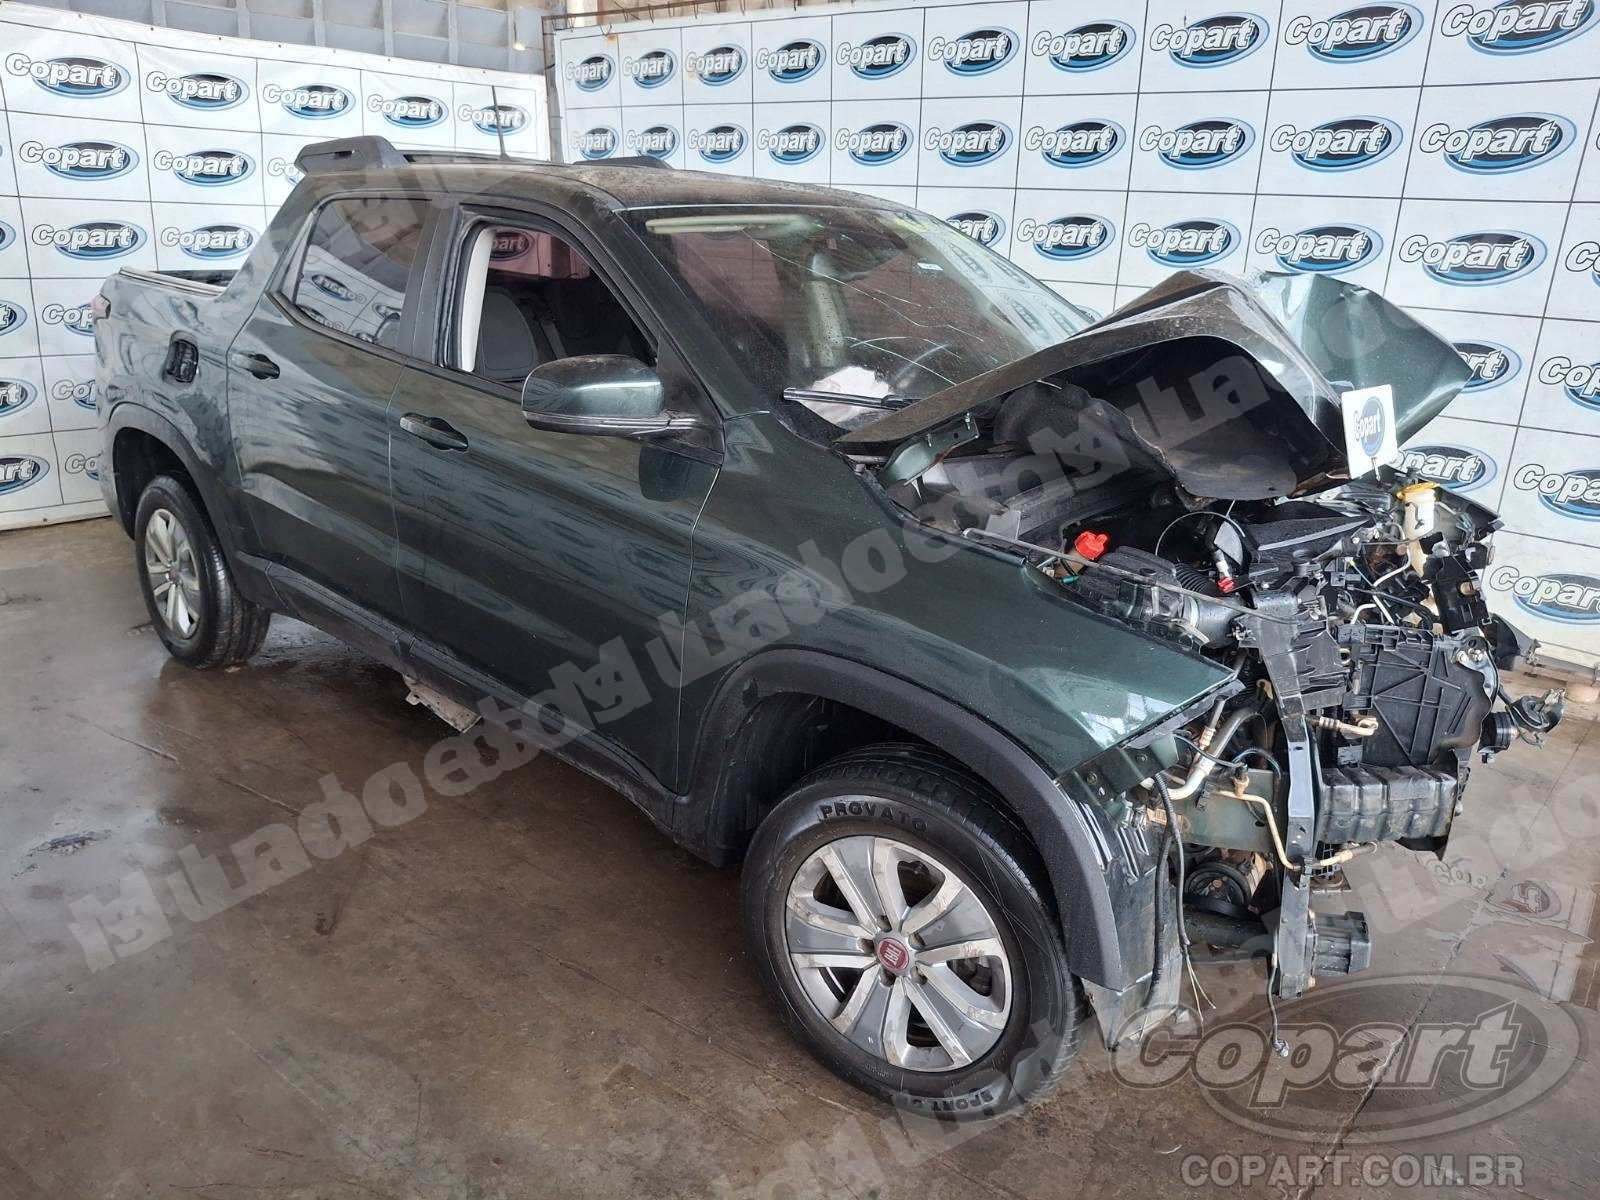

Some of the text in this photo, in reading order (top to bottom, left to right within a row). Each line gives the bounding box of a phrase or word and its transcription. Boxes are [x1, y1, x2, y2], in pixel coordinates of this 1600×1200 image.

[1285, 8, 1409, 52] Copart
[1441, 0, 1588, 43] Copart
[928, 32, 1008, 67] Copart
[1032, 26, 1122, 63] Copart
[1150, 19, 1254, 58] Copart
[5, 53, 117, 87] Copart
[623, 54, 671, 81] Copart
[685, 49, 738, 78] Copart
[756, 44, 817, 74] Copart
[836, 39, 907, 70] Copart
[146, 71, 237, 100] Copart
[565, 60, 609, 85] Copart
[263, 84, 345, 111] Copart
[367, 94, 439, 119] Copart
[458, 104, 522, 128] Copart
[20, 141, 124, 171] Copart
[570, 130, 614, 155] Copart
[625, 128, 673, 155] Copart
[688, 128, 740, 156] Copart
[757, 128, 817, 156] Copart
[835, 126, 904, 156] Copart
[924, 126, 1001, 157] Copart
[1025, 125, 1111, 158] Copart
[1139, 125, 1240, 159] Copart
[1270, 121, 1386, 160] Copart
[1419, 120, 1558, 162] Copart
[154, 150, 244, 176] Copart
[32, 224, 134, 251] Copart
[161, 227, 248, 250] Copart
[1017, 218, 1103, 249] Copart
[1129, 222, 1231, 256] Copart
[1255, 228, 1368, 262] Copart
[1399, 235, 1530, 273] Copart
[1354, 407, 1380, 443] Copart
[1490, 565, 1600, 611] Copar
[818, 801, 927, 832] PROVATO
